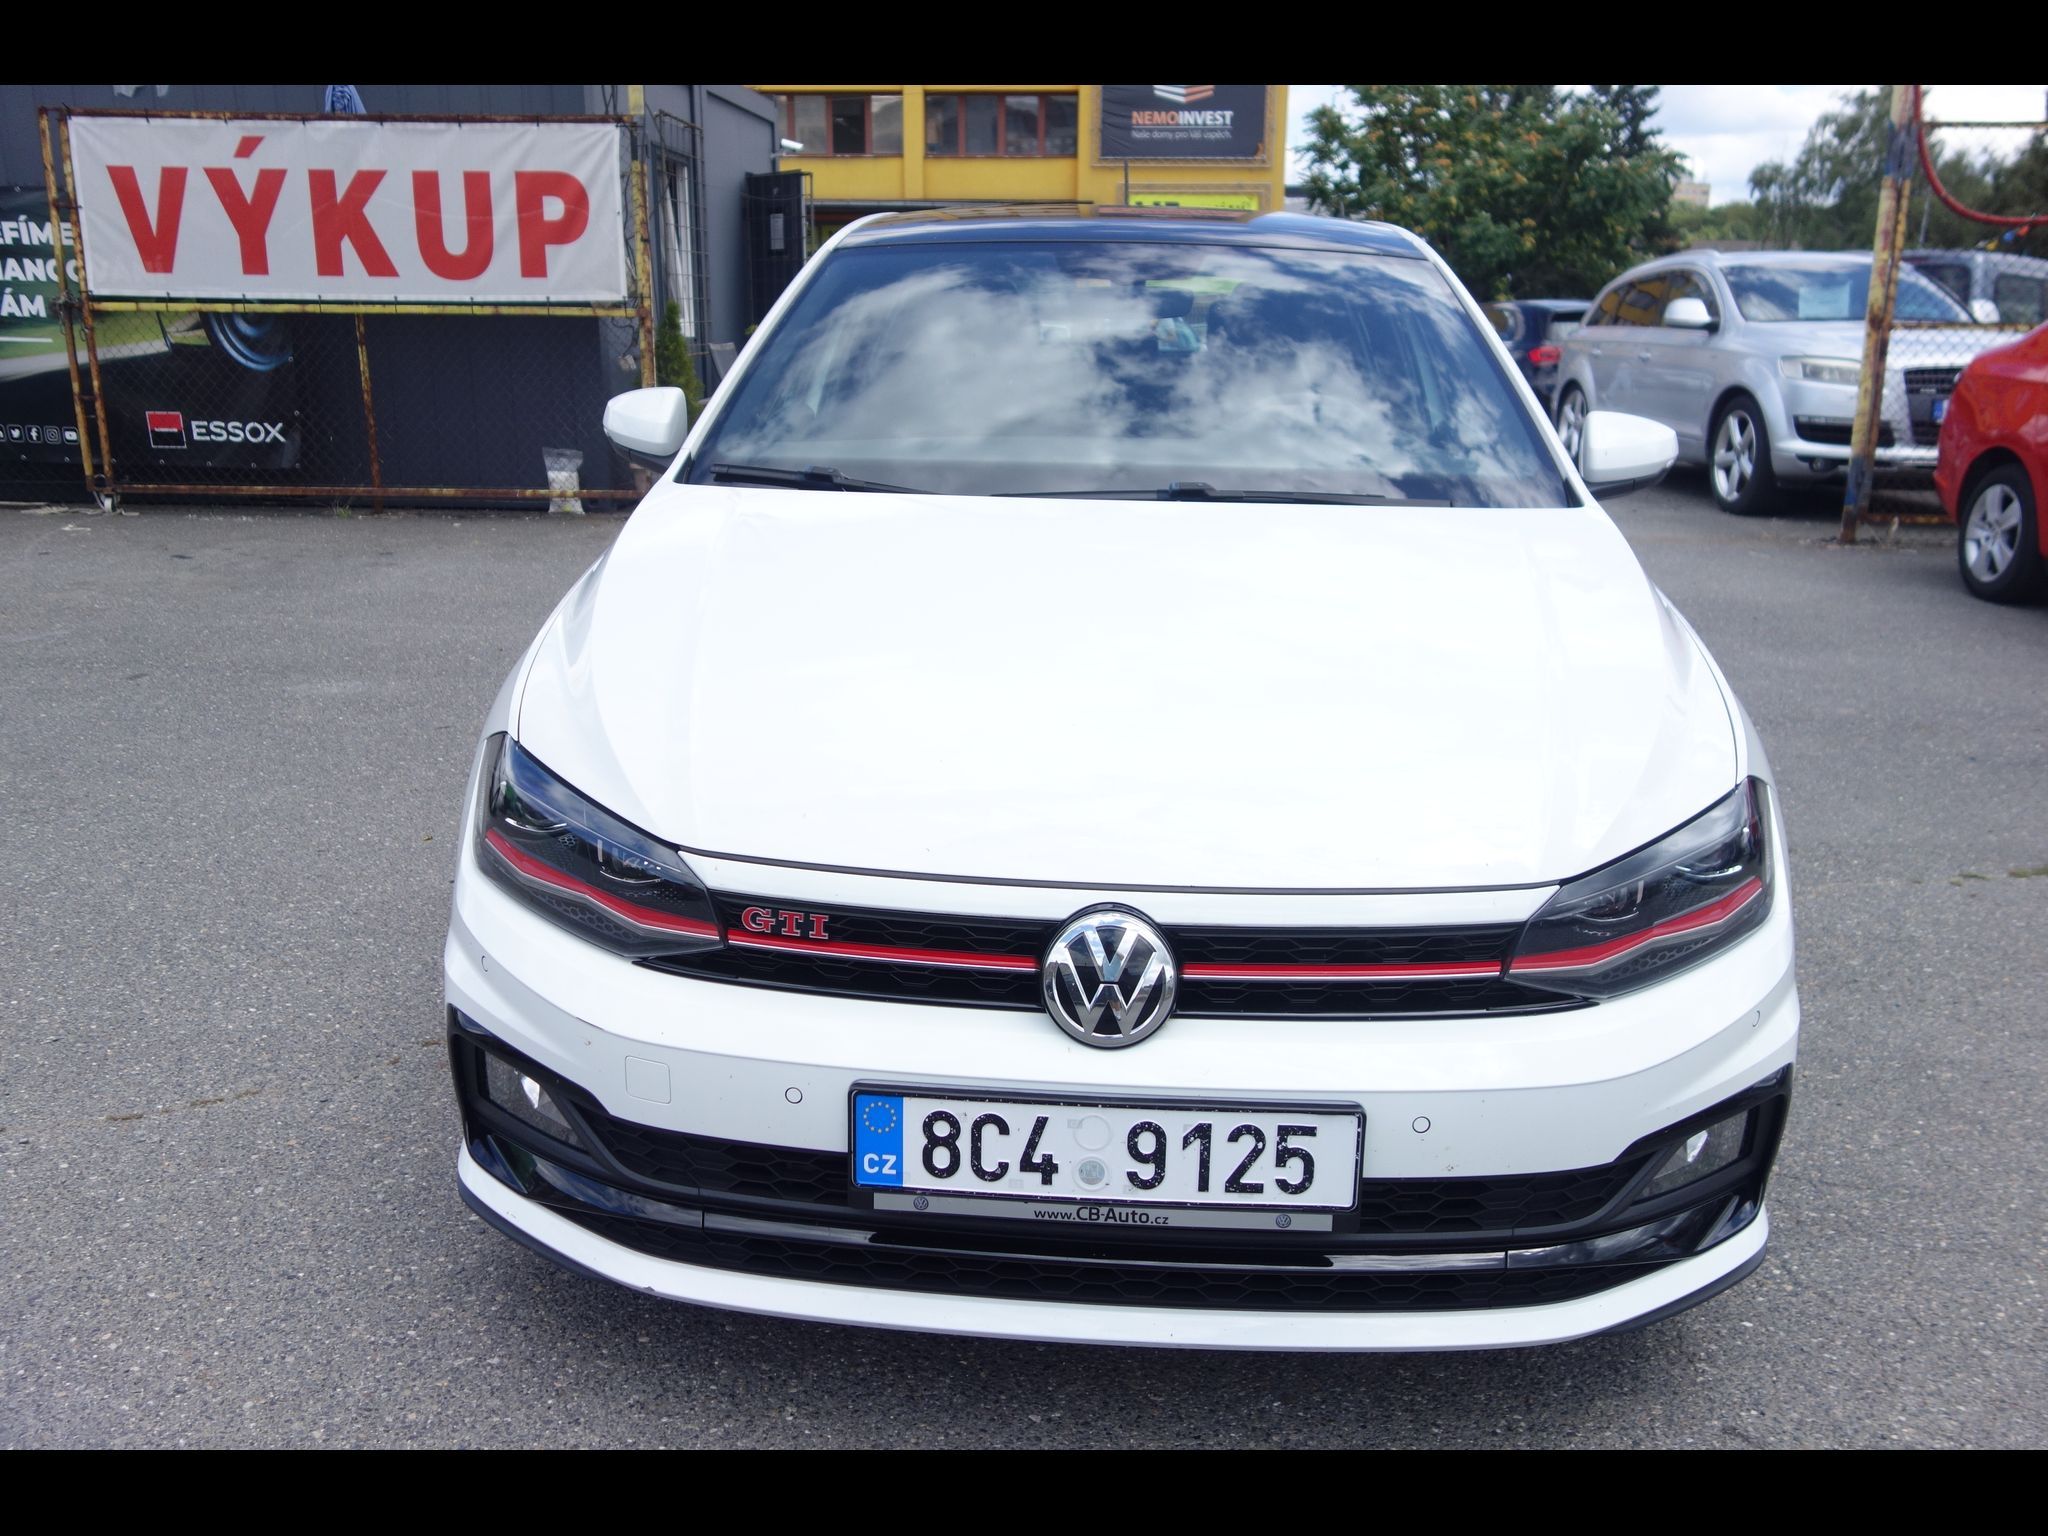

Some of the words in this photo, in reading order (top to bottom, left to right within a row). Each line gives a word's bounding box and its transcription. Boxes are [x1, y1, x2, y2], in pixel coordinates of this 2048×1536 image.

[1131, 110, 1234, 126] NEMOINVEST
[106, 135, 590, 281] VÝKUP
[190, 420, 287, 444] ESSOX
[741, 906, 829, 939] GTI
[863, 1152, 896, 1175] CZ
[921, 1109, 1059, 1186] 8C4
[1126, 1120, 1318, 1195] 9125
[1033, 1206, 1169, 1225] www.CB-Auto.cz
